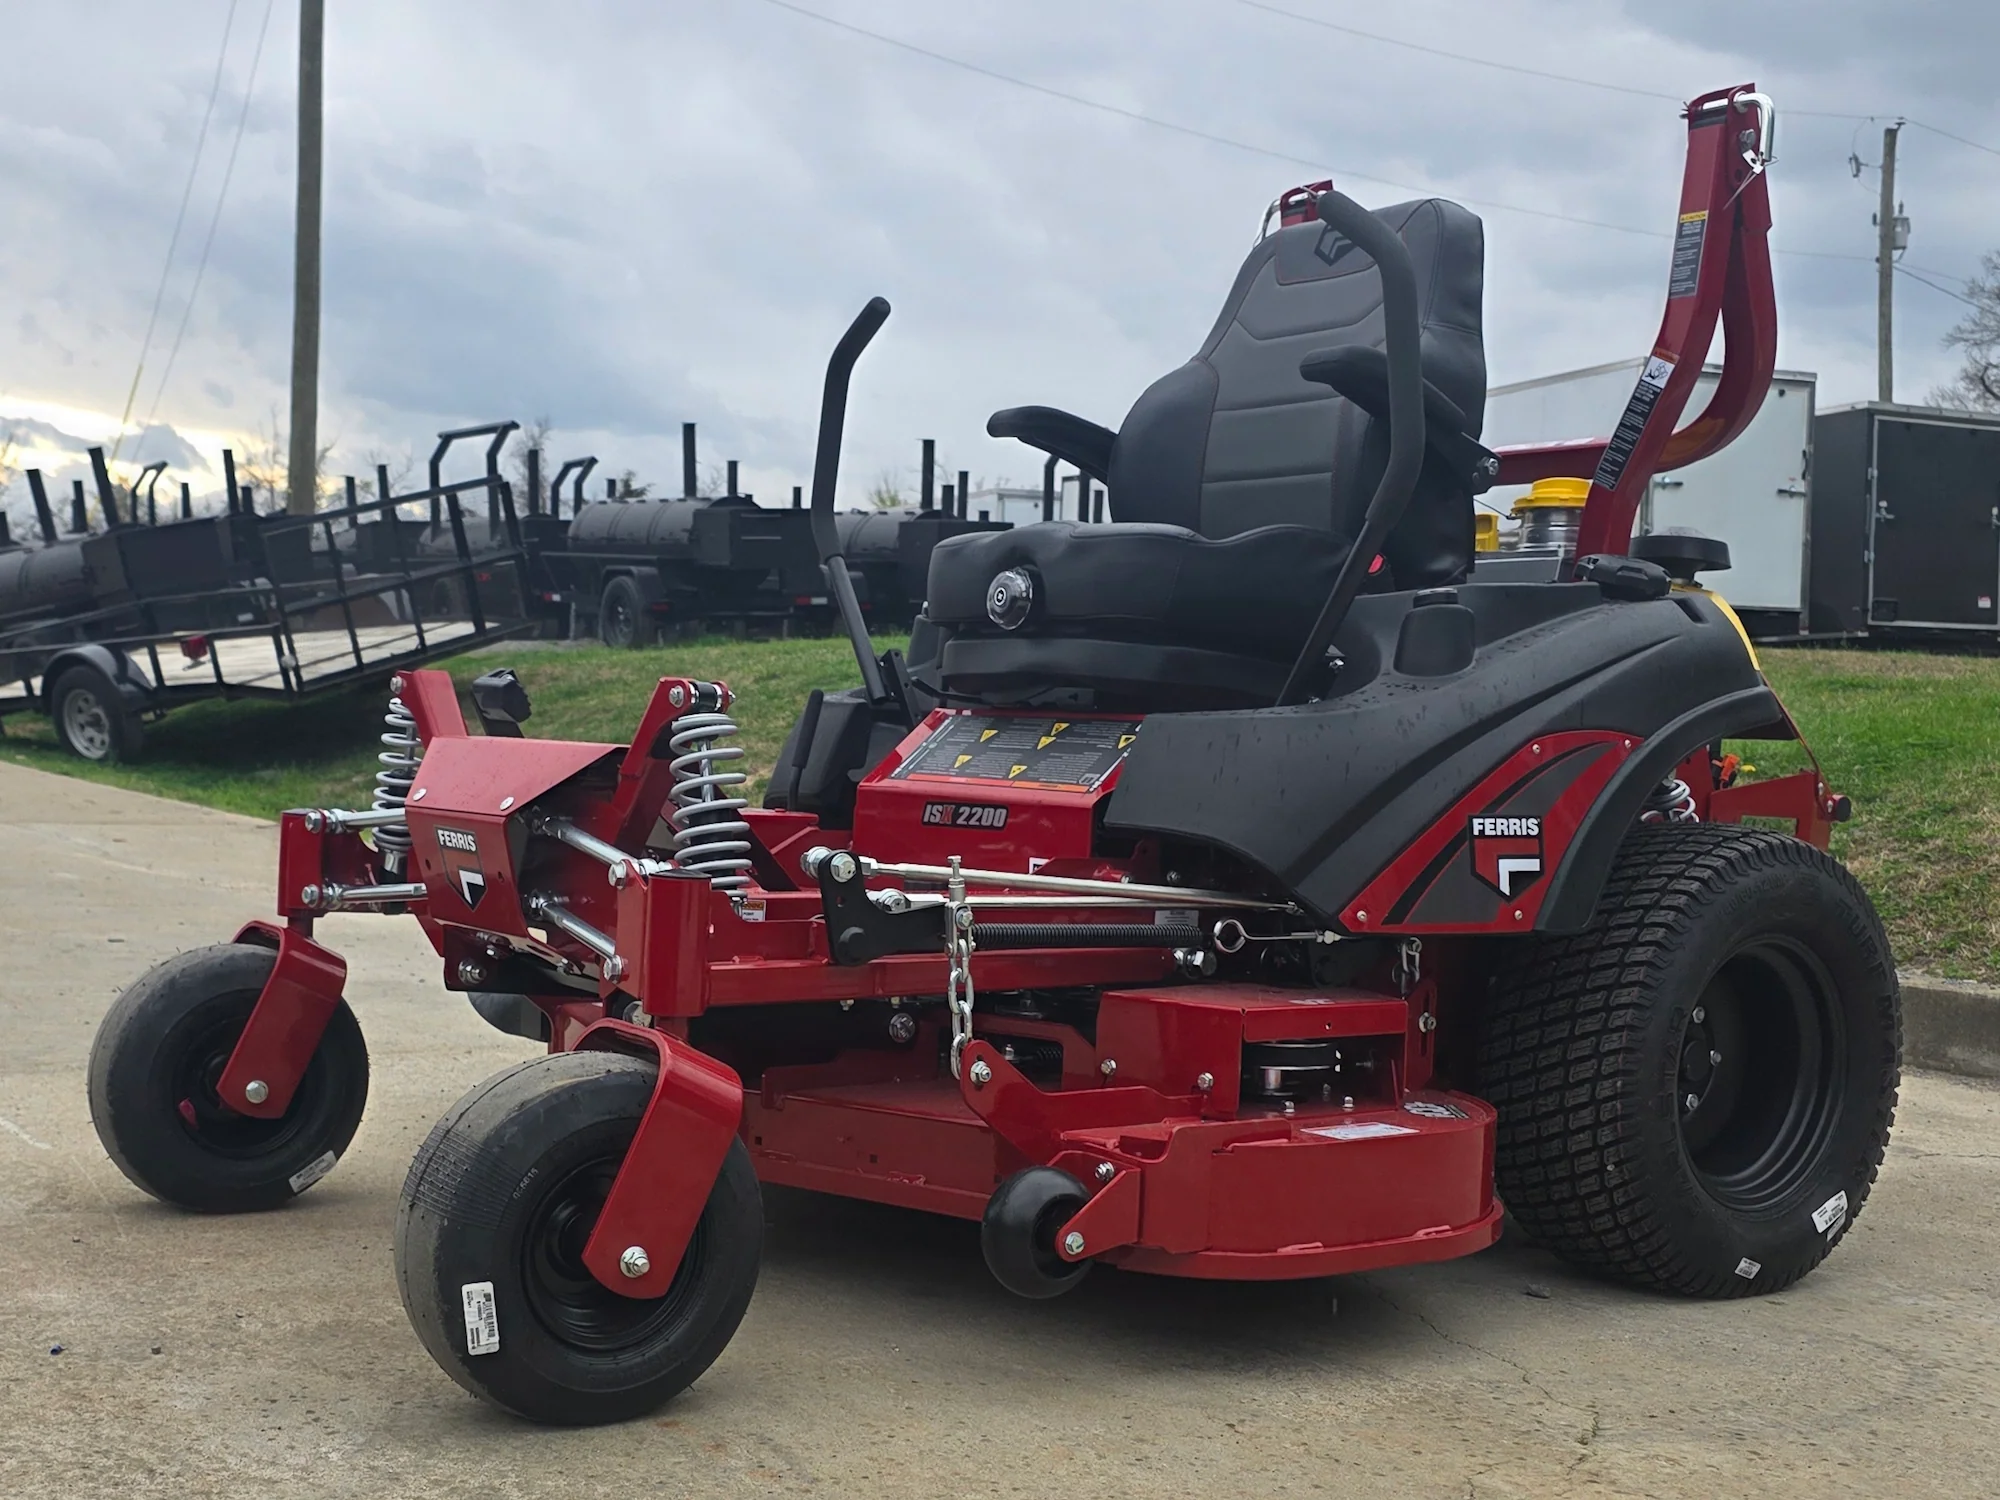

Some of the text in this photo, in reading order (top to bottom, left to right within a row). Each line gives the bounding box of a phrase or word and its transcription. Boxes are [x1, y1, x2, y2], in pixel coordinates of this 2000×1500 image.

[923, 804, 1008, 827] ISX 2200
[1472, 818, 1540, 836] FERRIS
[437, 829, 477, 852] FERRIS
